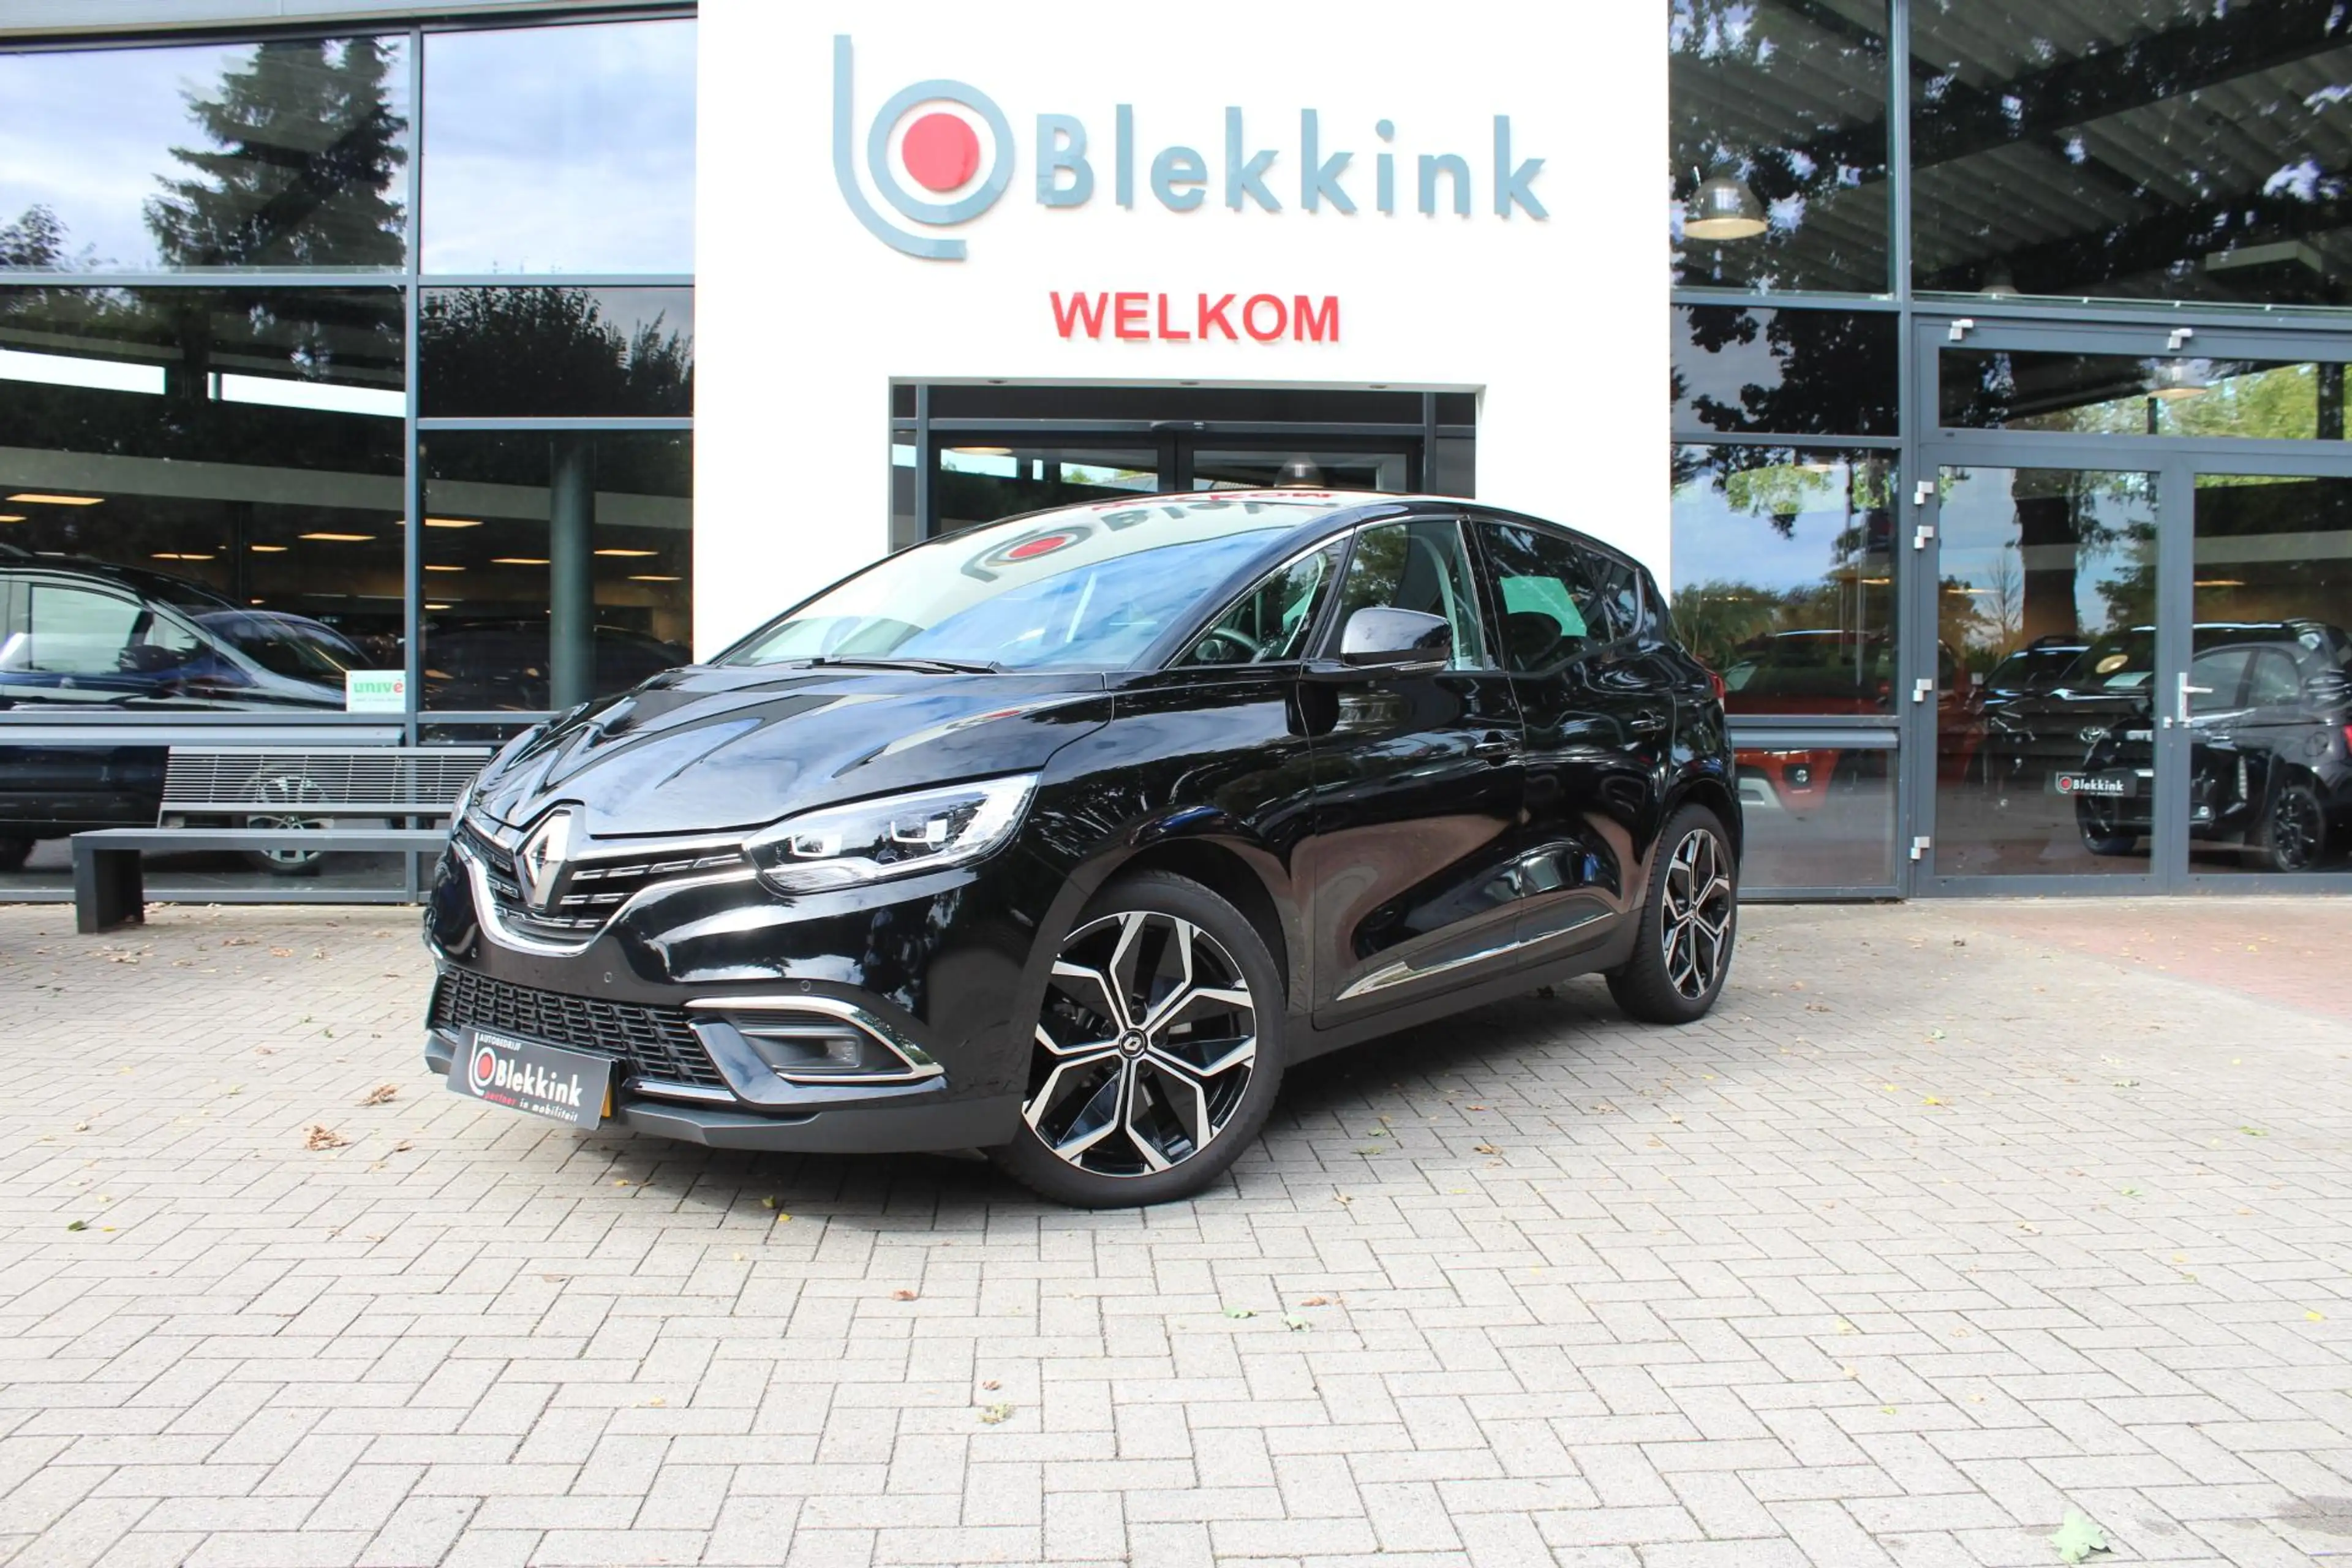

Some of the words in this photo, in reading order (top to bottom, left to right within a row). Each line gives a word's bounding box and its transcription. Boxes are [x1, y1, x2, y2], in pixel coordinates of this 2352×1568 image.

[1037, 104, 1548, 220] Blekkink
[1050, 291, 1340, 342] WELKOM
[2073, 778, 2124, 791] Blekkink
[484, 1090, 518, 1106] partner
[532, 1102, 578, 1122] mobiliteit
[494, 1059, 582, 1107] Blekkink
